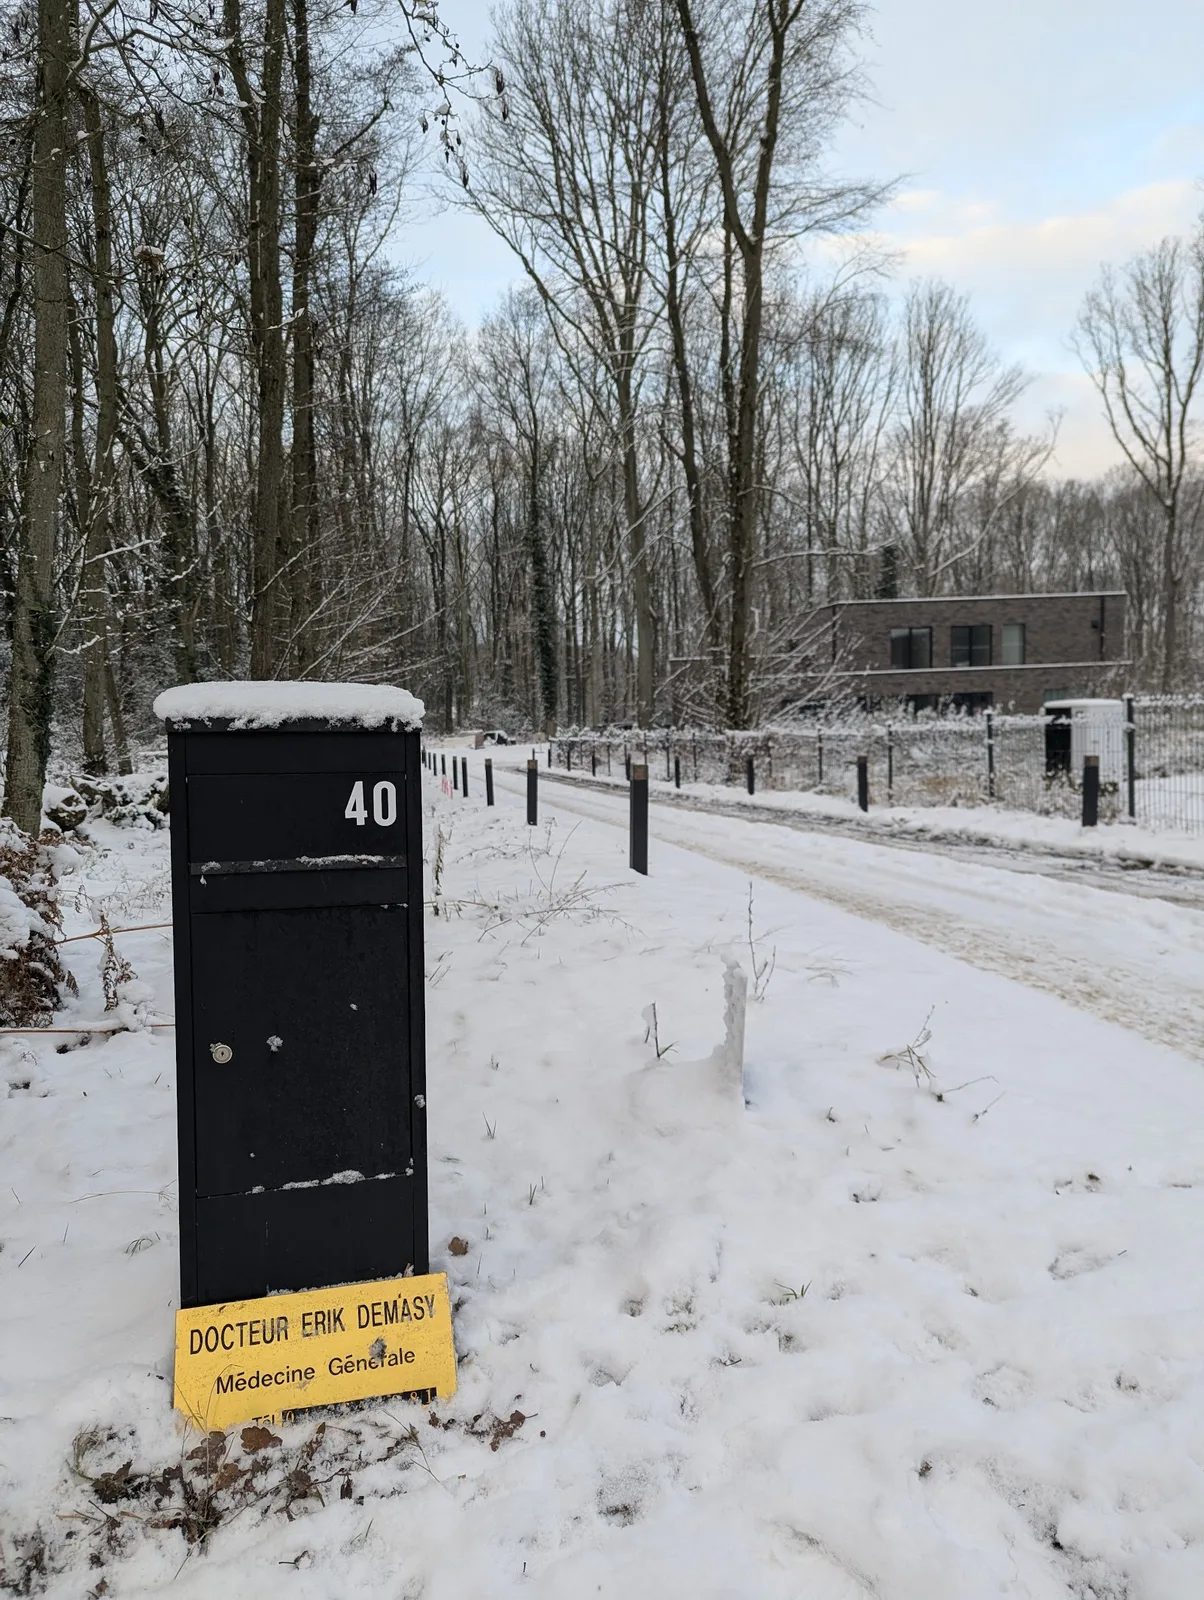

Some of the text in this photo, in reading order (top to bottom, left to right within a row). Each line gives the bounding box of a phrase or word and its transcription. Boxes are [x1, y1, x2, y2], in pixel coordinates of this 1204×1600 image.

[345, 780, 397, 827] 40
[190, 1294, 436, 1355] DOCTEUR ERIK DEMASY
[216, 1365, 315, 1395] Médecine
